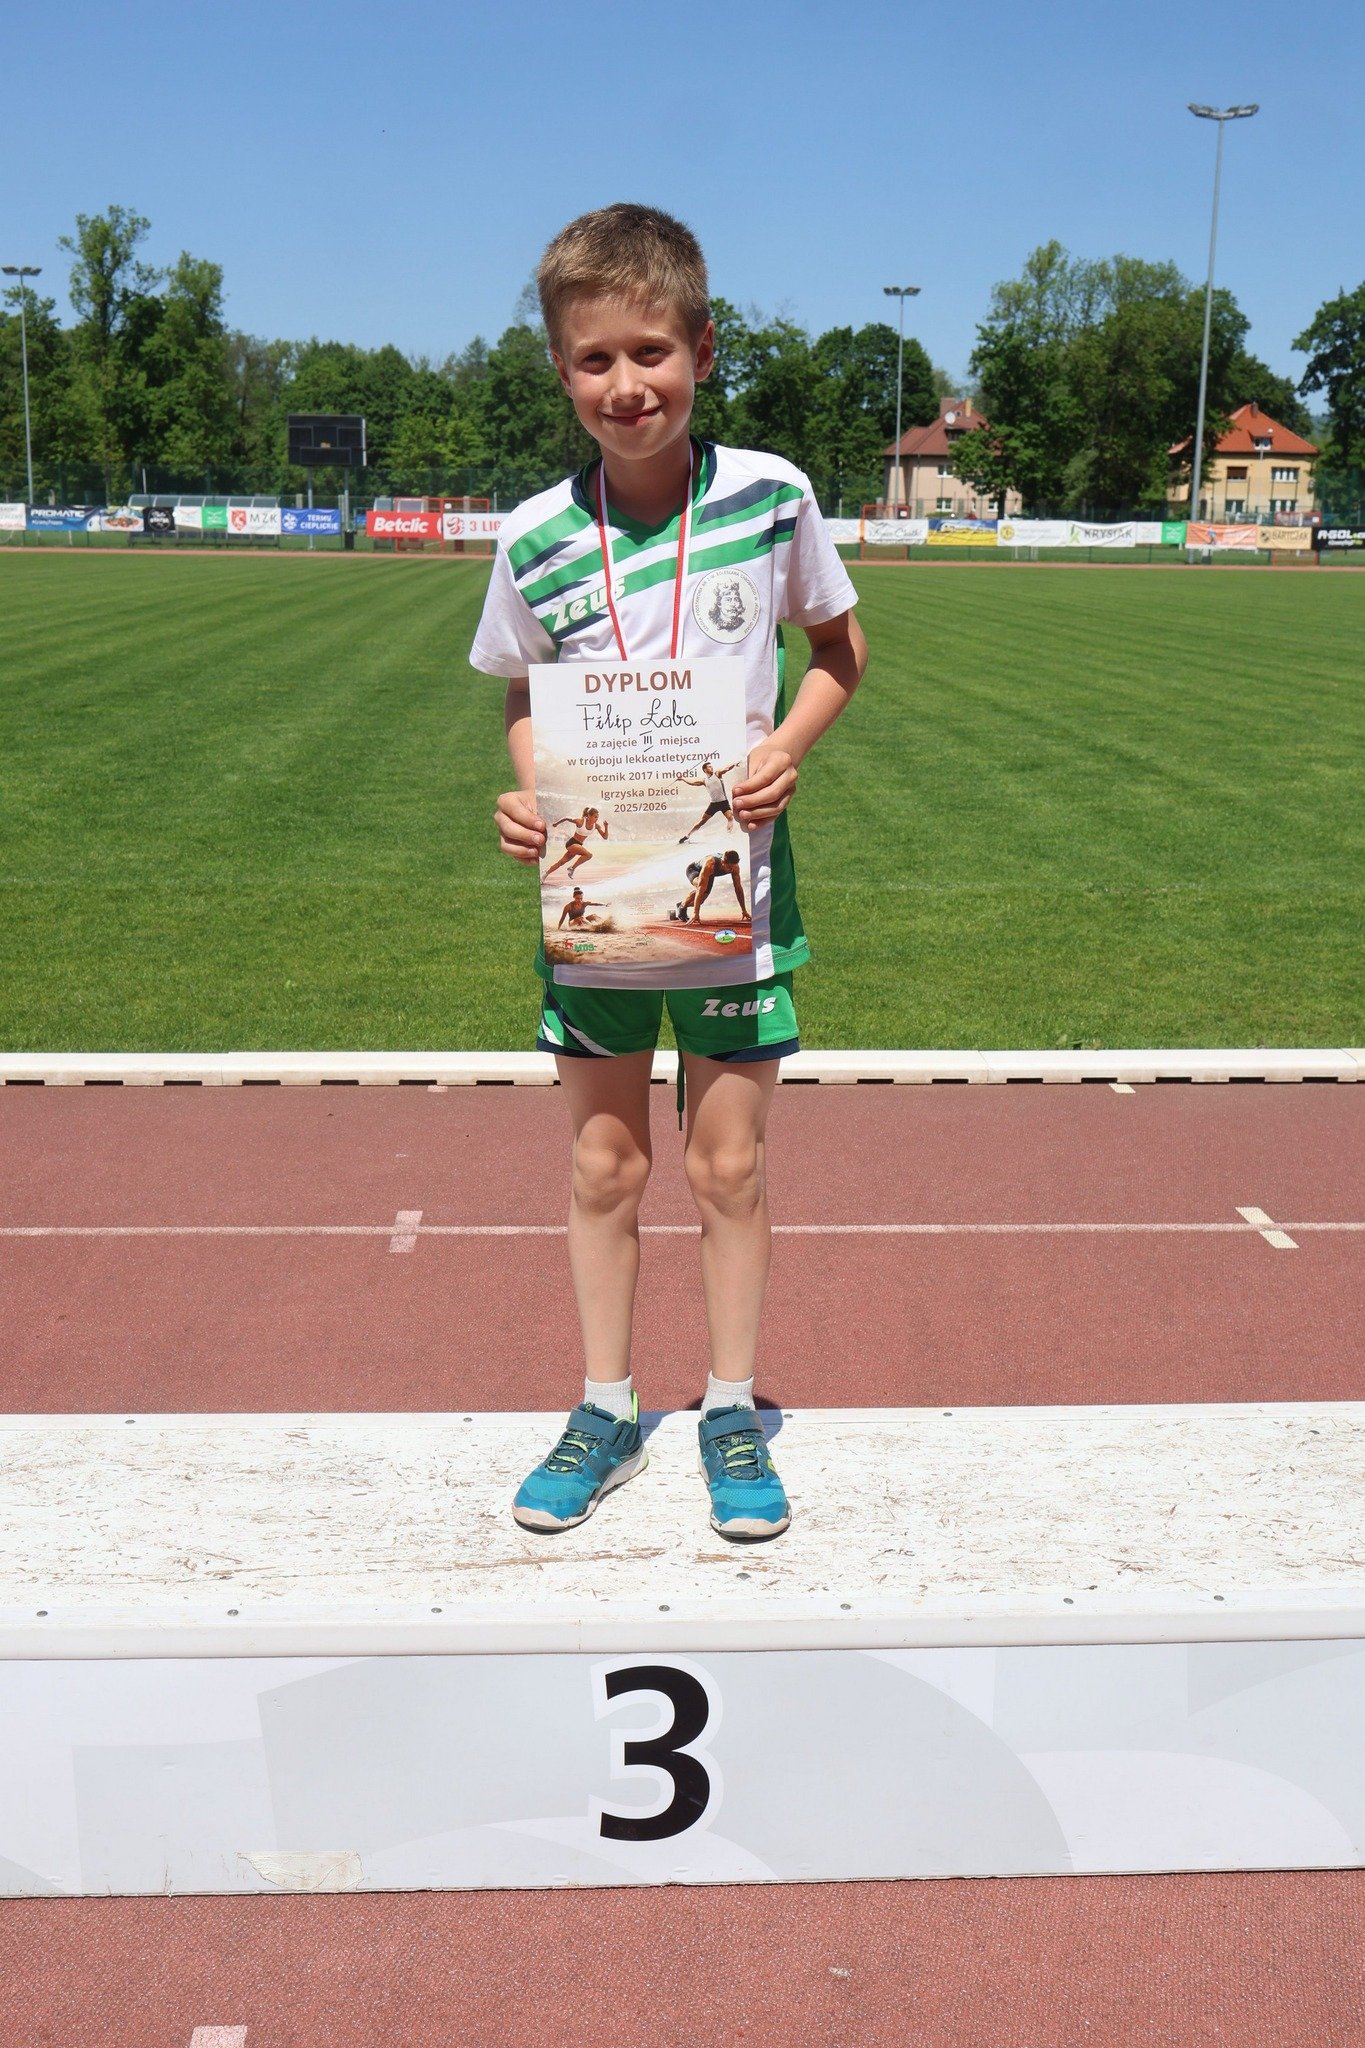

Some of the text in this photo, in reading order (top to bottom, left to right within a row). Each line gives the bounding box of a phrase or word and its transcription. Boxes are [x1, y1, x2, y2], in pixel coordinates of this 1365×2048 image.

[31, 509, 85, 517] PROMATIC
[250, 513, 277, 524] MZK
[373, 517, 429, 533] Betclic
[469, 520, 502, 532] 3 LIG
[584, 670, 692, 693] DYPLOM
[576, 703, 632, 735] Filip
[586, 740, 598, 748] za
[600, 738, 638, 750] zajęcie
[659, 735, 700, 747] miejsca
[567, 751, 720, 768] w trójboju lekkoatletycznym
[586, 771, 626, 782] rocznik
[628, 771, 653, 781] 2017
[662, 769, 698, 780] młodsi
[600, 786, 679, 801] Igrzyska Dzieci
[614, 802, 667, 813] 2025/2026
[701, 996, 777, 1018] Zeus
[600, 1665, 711, 1842] 3
